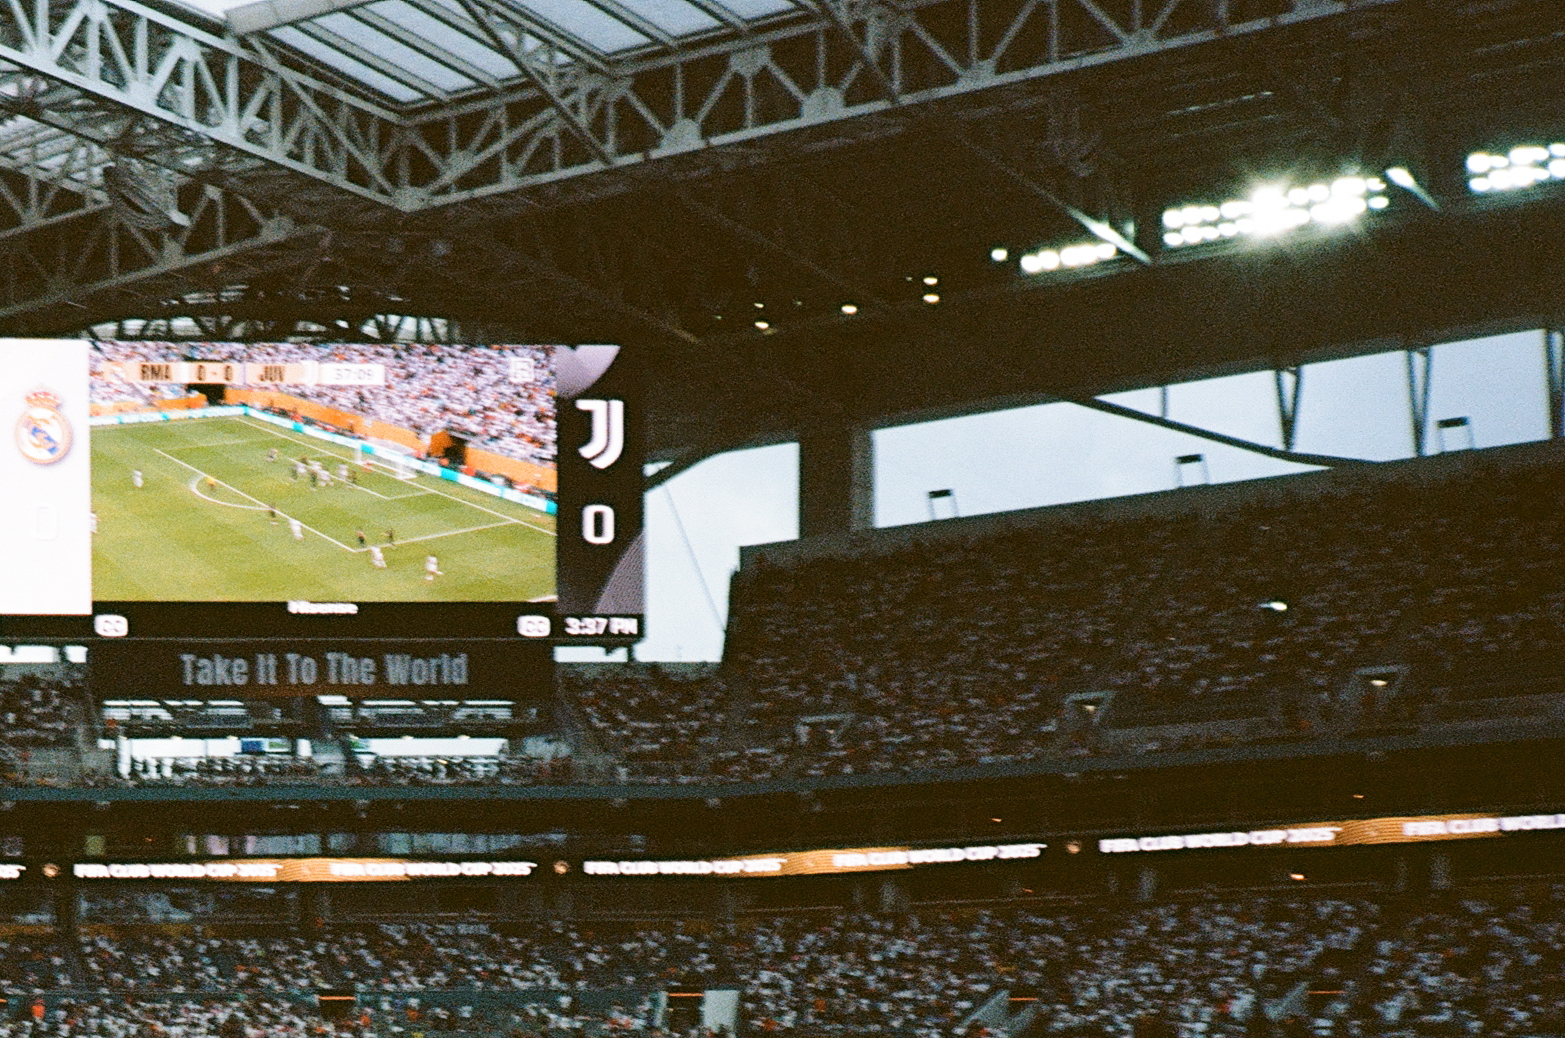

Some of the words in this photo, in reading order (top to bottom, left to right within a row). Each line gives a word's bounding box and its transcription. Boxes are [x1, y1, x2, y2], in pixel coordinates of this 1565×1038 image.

[139, 363, 173, 381] RMA
[257, 364, 285, 382] JUV
[582, 504, 615, 544] 0
[564, 617, 608, 634] 3:37
[609, 617, 638, 634] PM
[180, 653, 248, 686] Take
[257, 653, 277, 685] It
[285, 653, 317, 685] To
[326, 652, 377, 685] The
[385, 653, 469, 685] World
